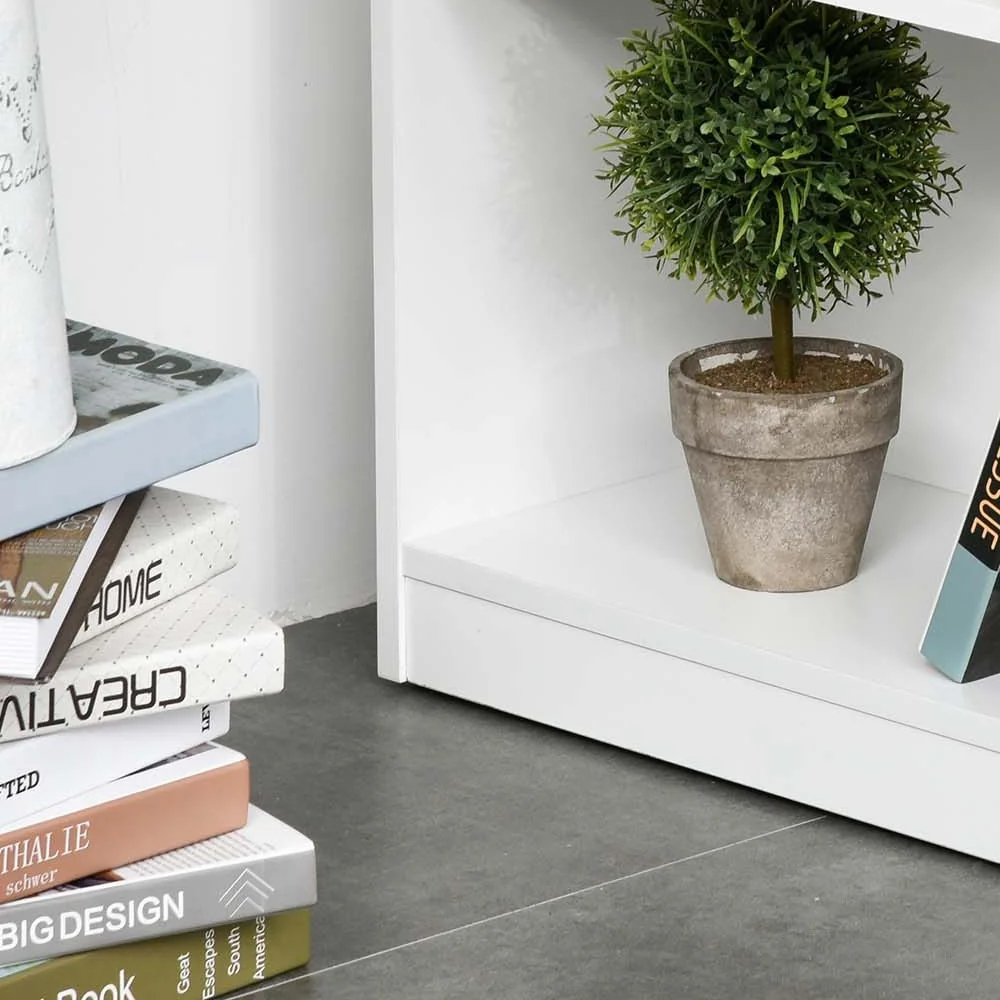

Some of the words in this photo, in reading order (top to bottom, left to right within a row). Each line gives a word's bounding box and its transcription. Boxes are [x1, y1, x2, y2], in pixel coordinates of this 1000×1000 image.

[67, 326, 224, 387] MODA
[84, 558, 162, 631] HOME
[6, 869, 58, 896] schwer
[0, 915, 54, 950] BIG
[60, 891, 184, 940] DESIGN
[253, 915, 265, 980] America
[177, 951, 191, 994] Geat
[203, 928, 218, 1000] Escapes
[228, 926, 241, 976] South
